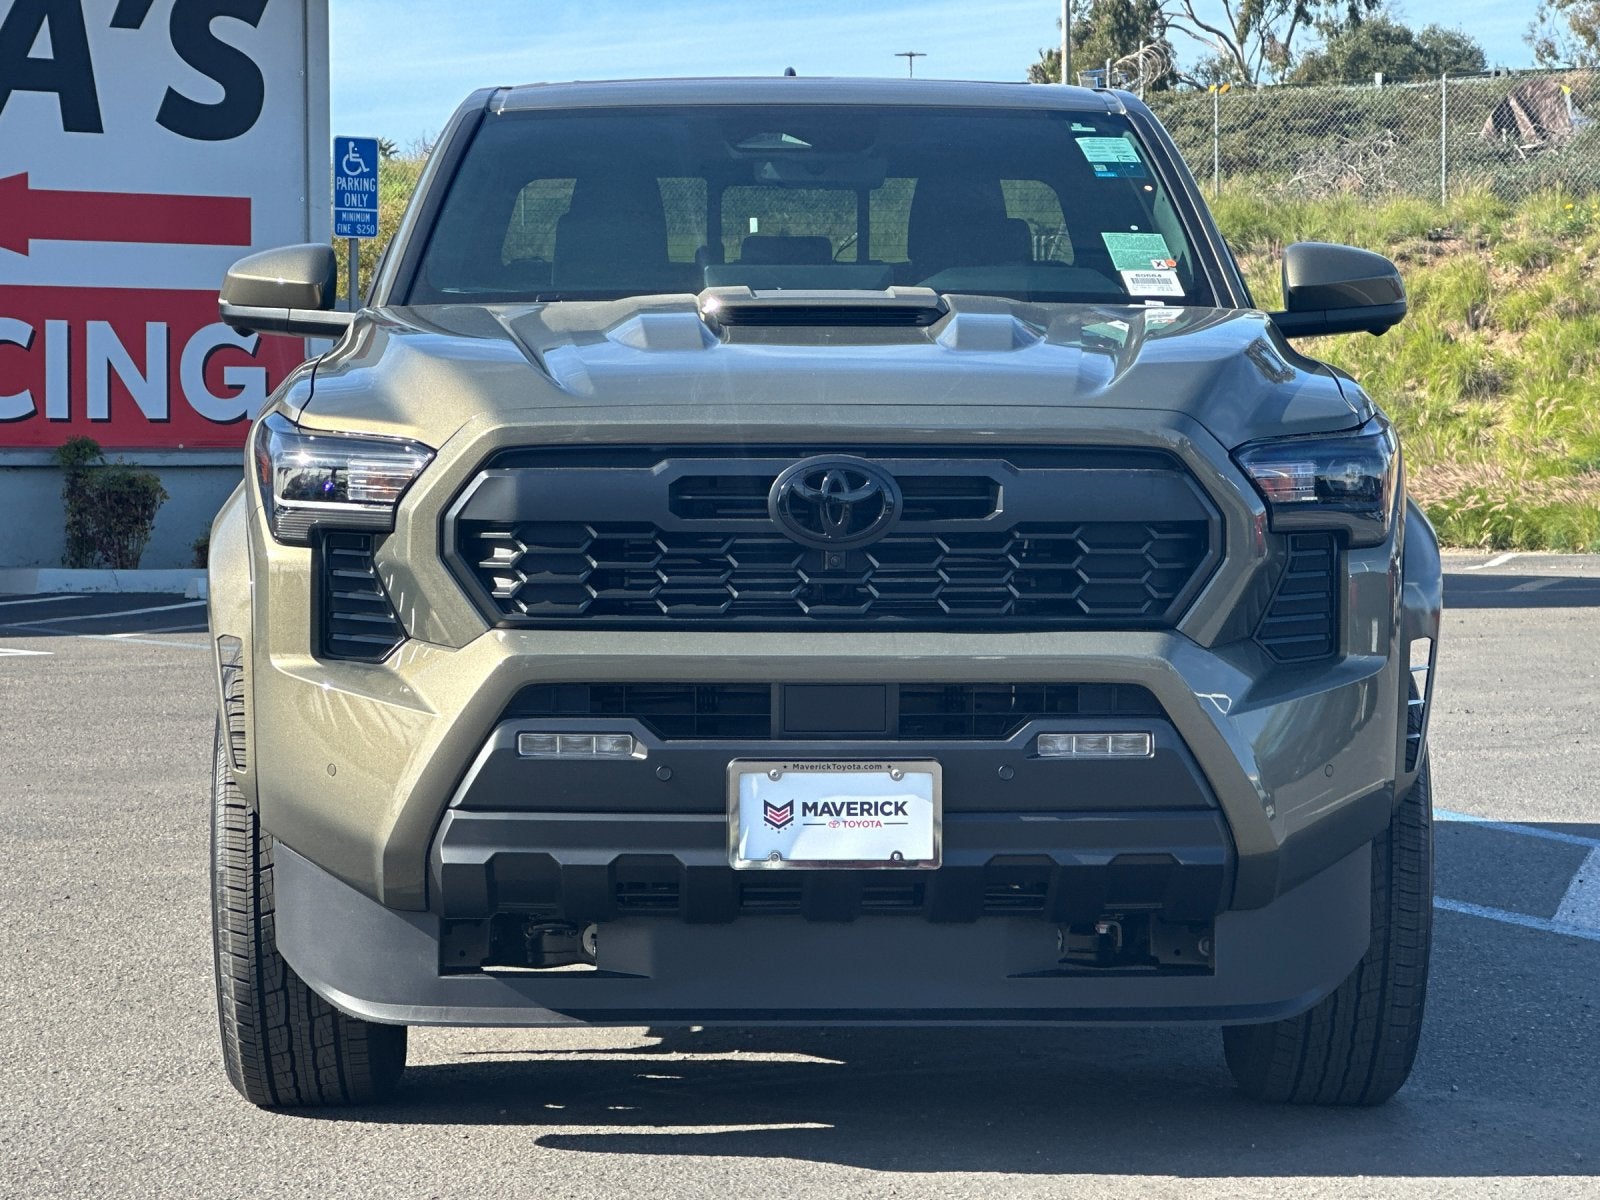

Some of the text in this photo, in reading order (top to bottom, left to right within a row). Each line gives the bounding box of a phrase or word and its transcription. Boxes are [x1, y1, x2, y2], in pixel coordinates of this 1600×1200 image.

[336, 177, 376, 191] PARKING
[344, 193, 368, 207] ONLY
[342, 212, 371, 222] MINIMUM
[337, 224, 375, 235] FINE $250
[792, 763, 883, 771] MaverickToyota.com
[801, 801, 909, 817] MAVERICK
[842, 820, 883, 828] TOYOTA
